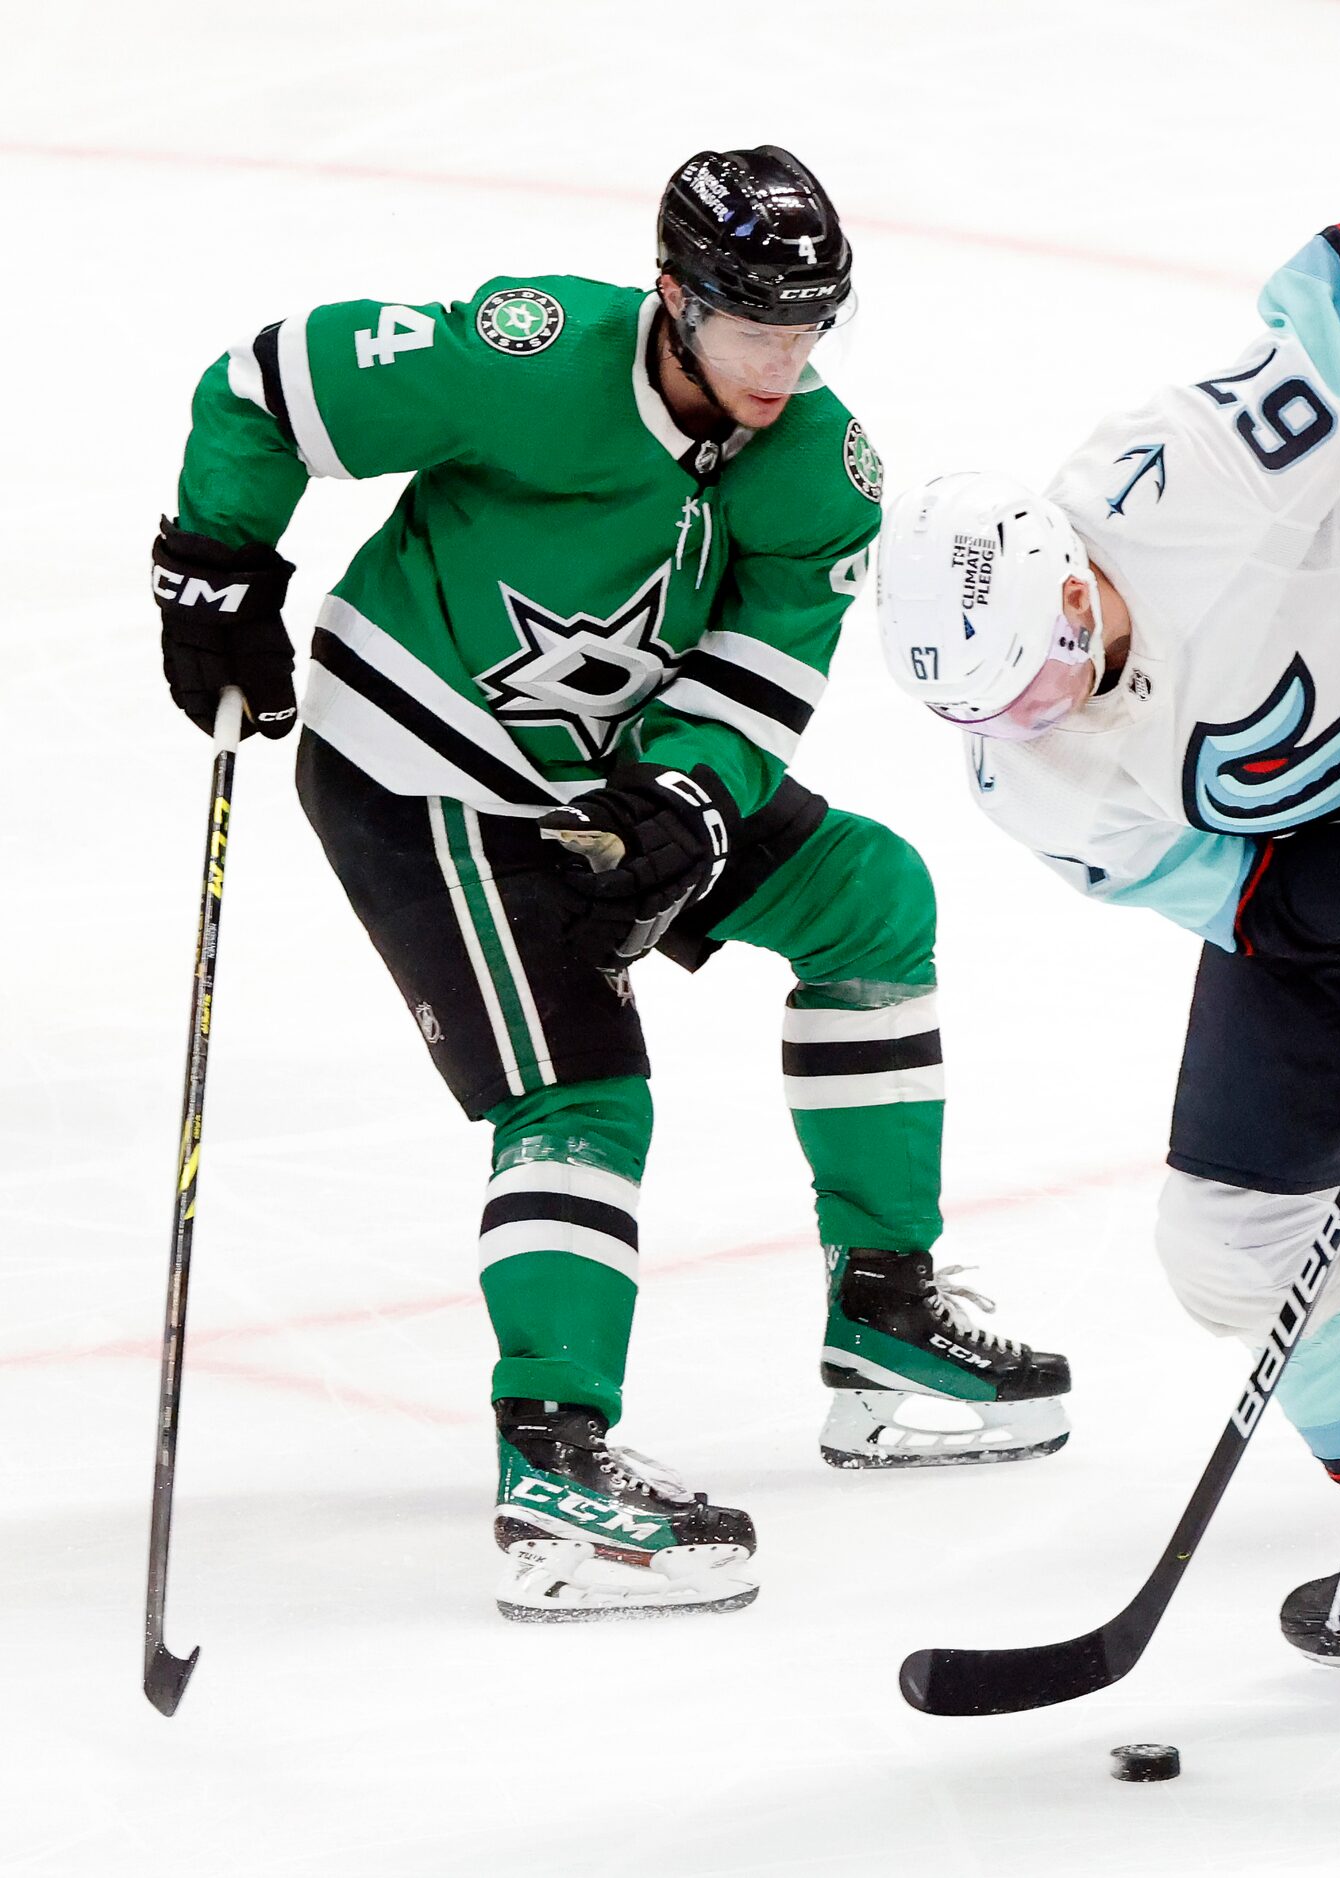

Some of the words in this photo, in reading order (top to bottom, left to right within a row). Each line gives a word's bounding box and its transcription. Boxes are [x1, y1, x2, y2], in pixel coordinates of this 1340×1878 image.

[799, 235, 817, 265] 4
[779, 284, 837, 300] CCM
[354, 305, 436, 369] 4
[911, 647, 940, 680] 67
[928, 1333, 993, 1369] CCM
[510, 1475, 664, 1542] CCM
